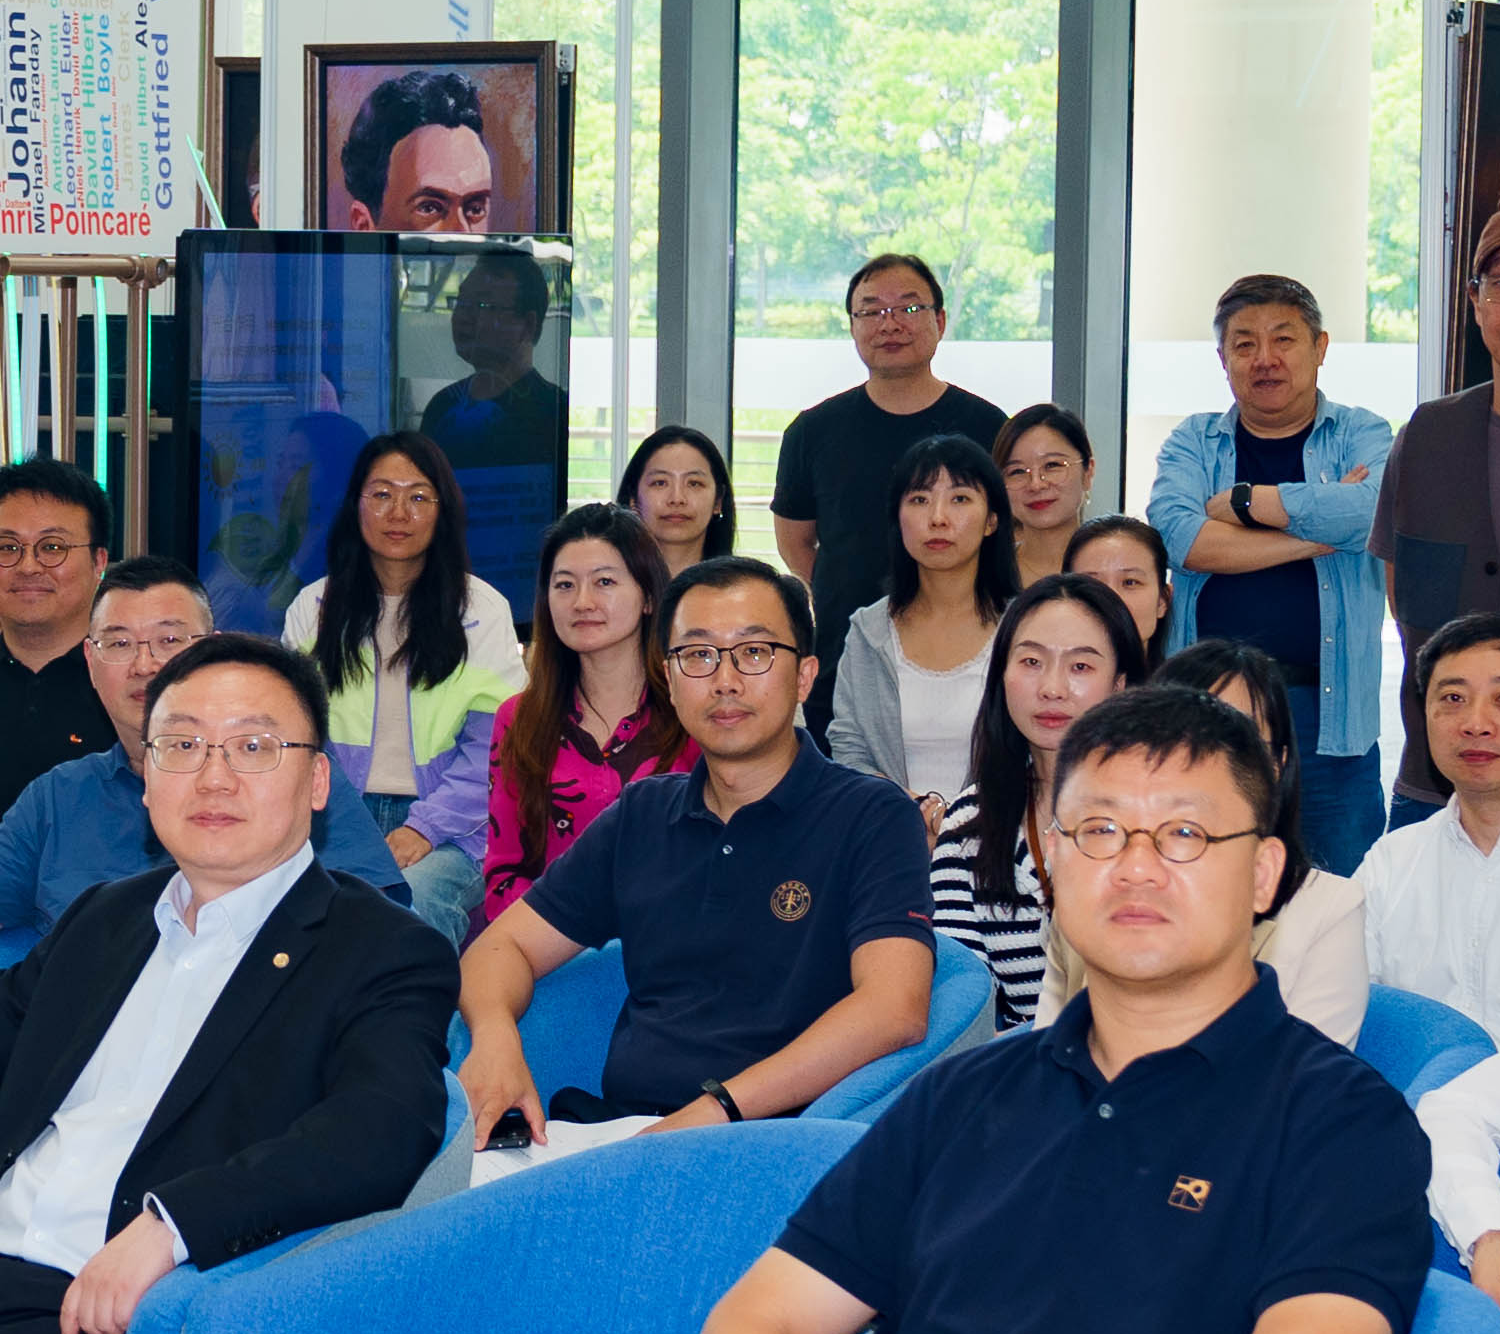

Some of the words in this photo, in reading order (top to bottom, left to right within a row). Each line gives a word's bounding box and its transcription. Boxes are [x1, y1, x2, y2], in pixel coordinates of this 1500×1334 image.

[60, 11, 72, 74] Euler
[71, 11, 79, 45] Bohr
[81, 12, 96, 108] Hilbert
[97, 14, 113, 93] Boyle
[6, 11, 31, 199] Johann
[29, 28, 42, 122] Faraday
[49, 22, 63, 195] Antoine-Laurent
[72, 55, 80, 97] David
[136, 55, 149, 127] Hilbert
[61, 92, 77, 208] Leonhard
[74, 107, 83, 155] Henrik
[99, 114, 114, 209] Robert
[119, 103, 135, 192] James
[151, 33, 173, 210] Gottfried
[31, 141, 46, 234] Michael
[84, 129, 99, 209] David
[137, 141, 150, 202] David
[50, 202, 151, 236] Poincaré
